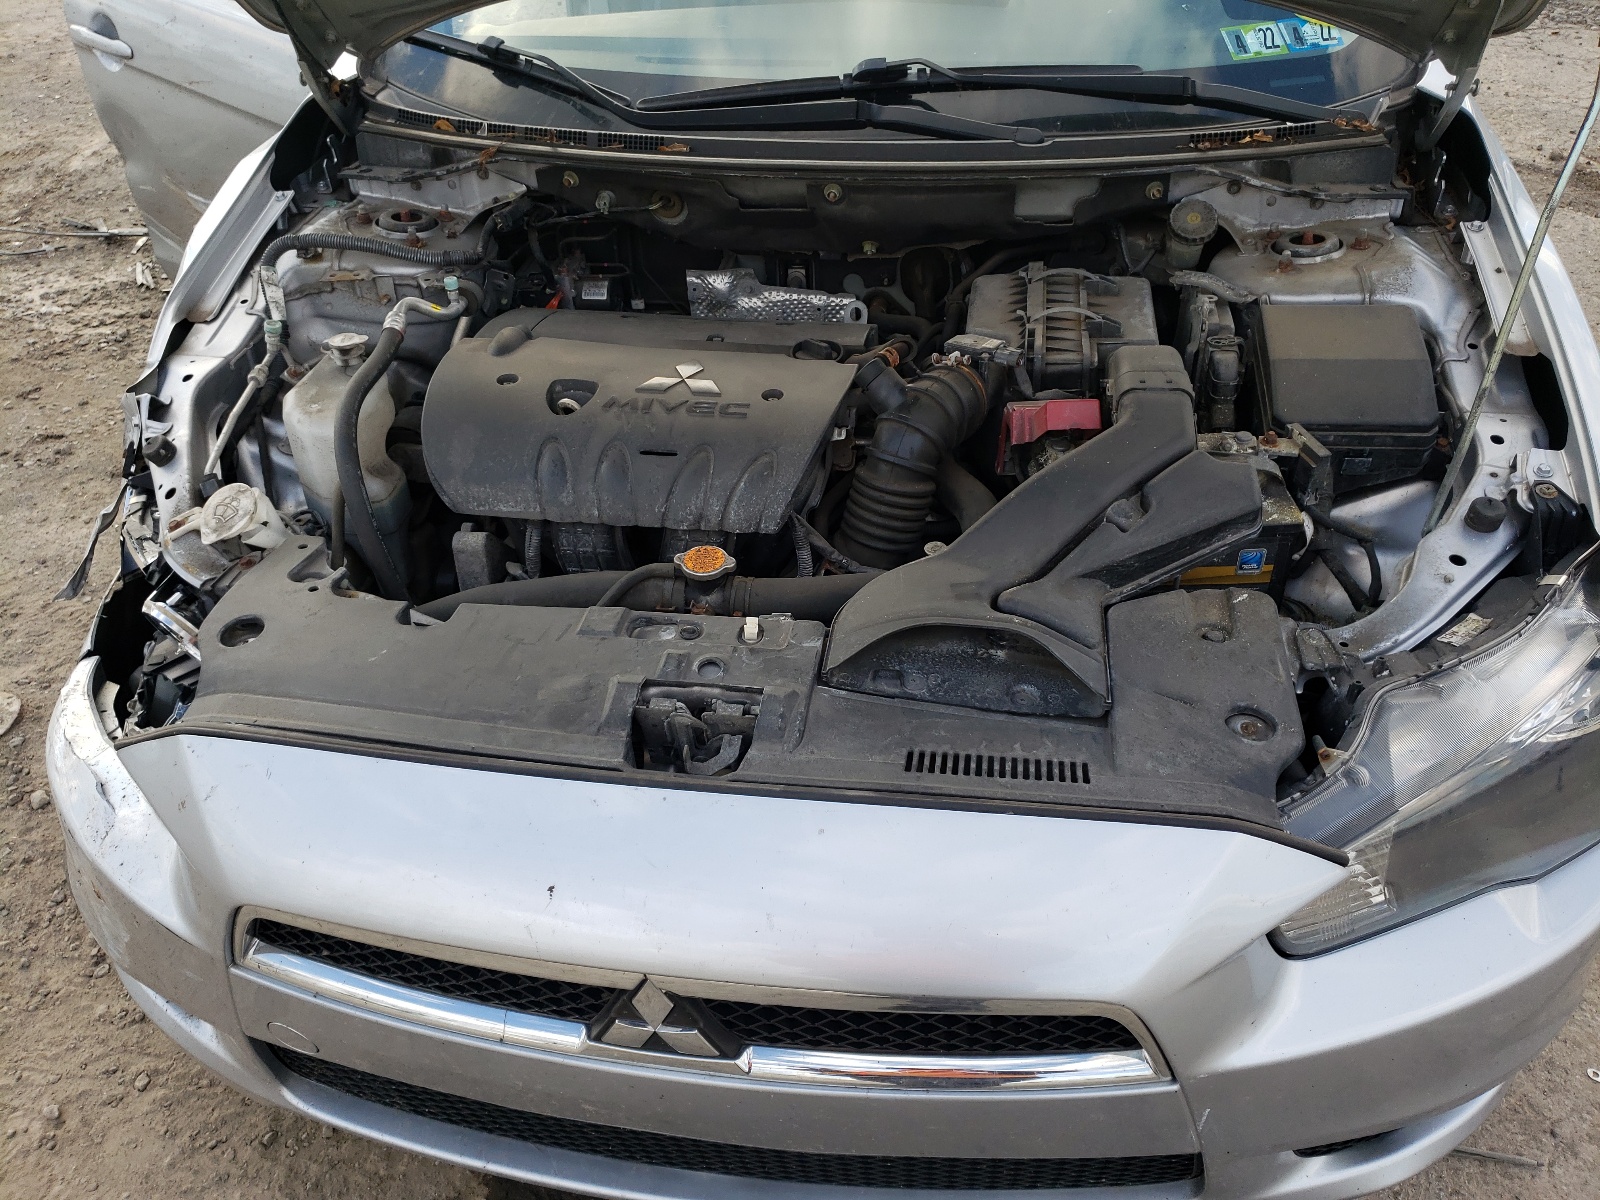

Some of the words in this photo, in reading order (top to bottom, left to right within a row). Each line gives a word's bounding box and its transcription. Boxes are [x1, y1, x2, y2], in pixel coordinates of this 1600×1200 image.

[1234, 34, 1248, 54] 4
[1257, 26, 1281, 50] 22
[601, 394, 751, 419] MIVEC
